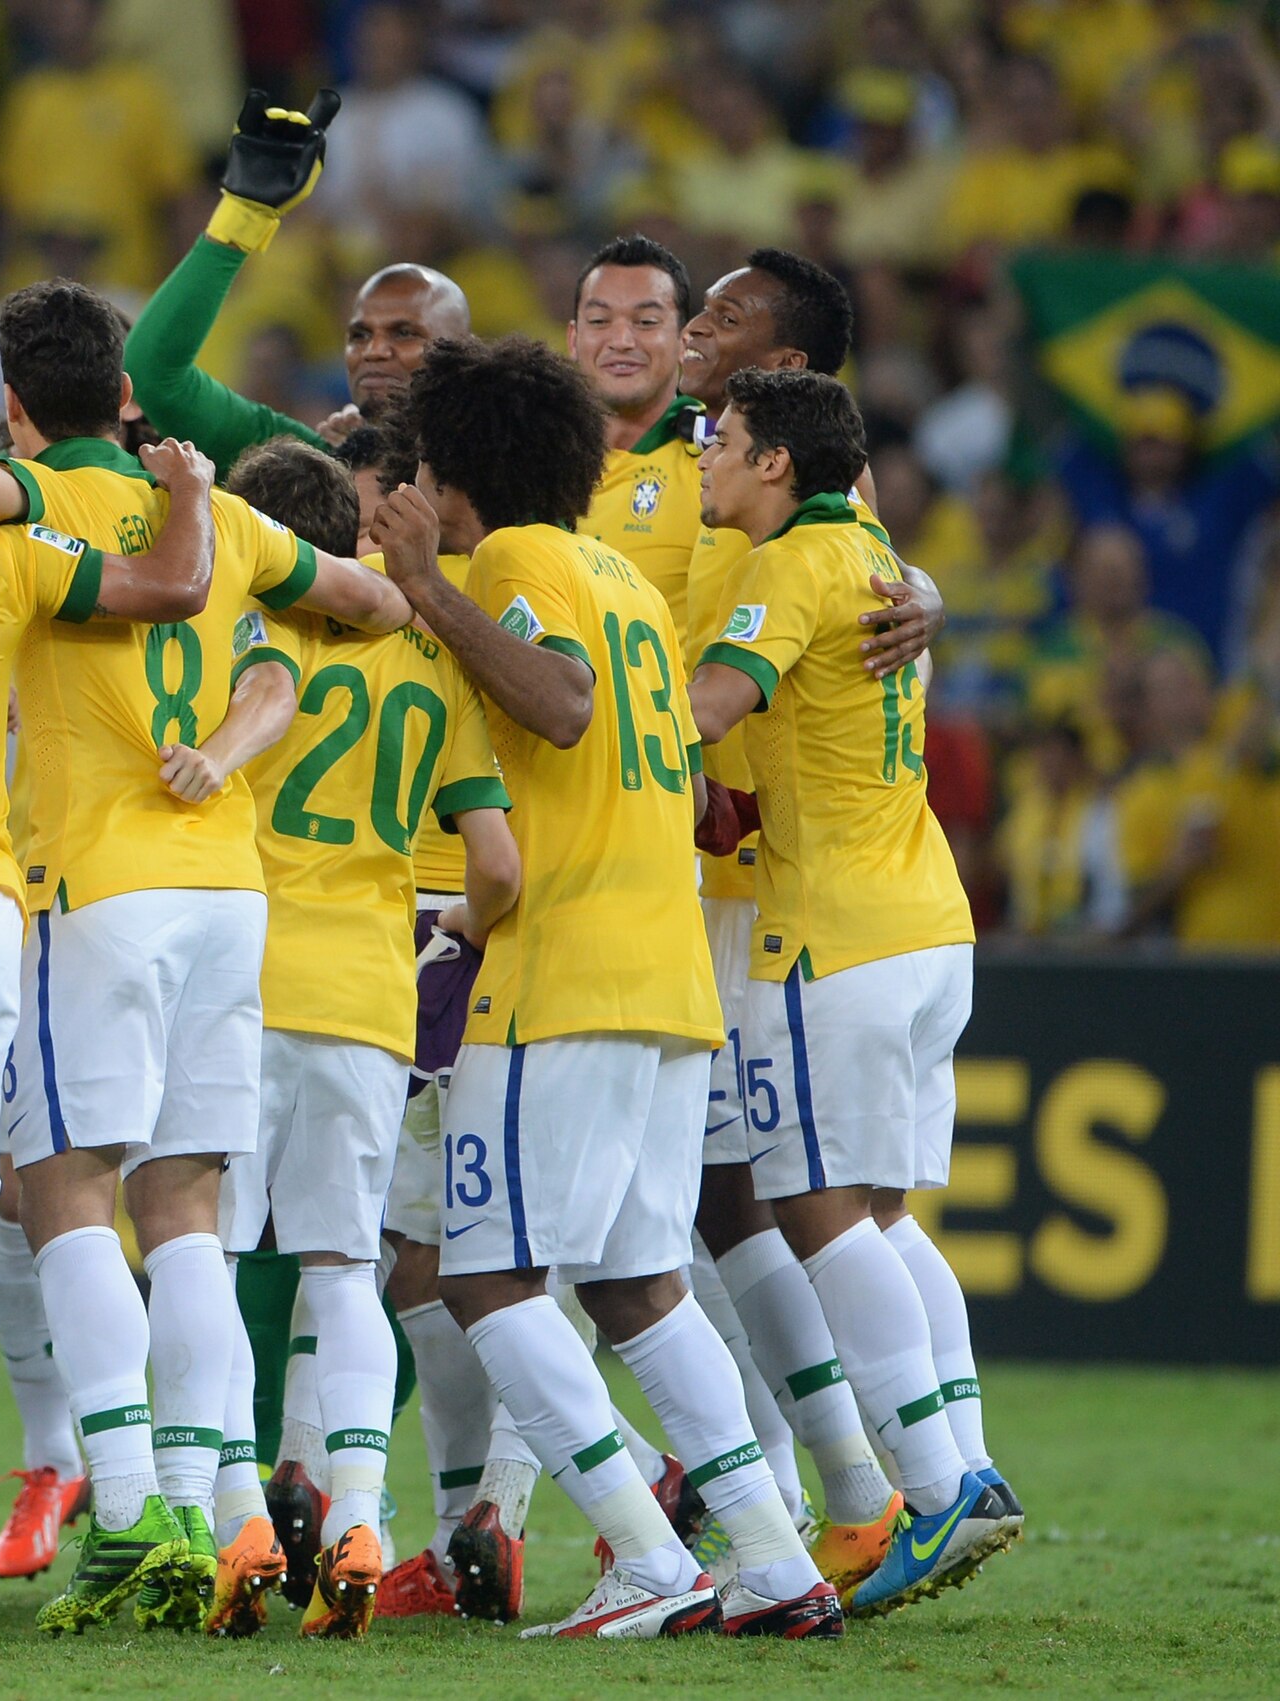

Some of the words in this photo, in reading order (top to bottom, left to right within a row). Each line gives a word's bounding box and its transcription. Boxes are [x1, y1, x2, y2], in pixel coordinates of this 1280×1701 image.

[578, 546, 639, 590] DANTE
[604, 611, 686, 795] 13
[272, 664, 447, 857] 20
[445, 1134, 492, 1209] 13
[156, 1432, 200, 1445] BRASIL
